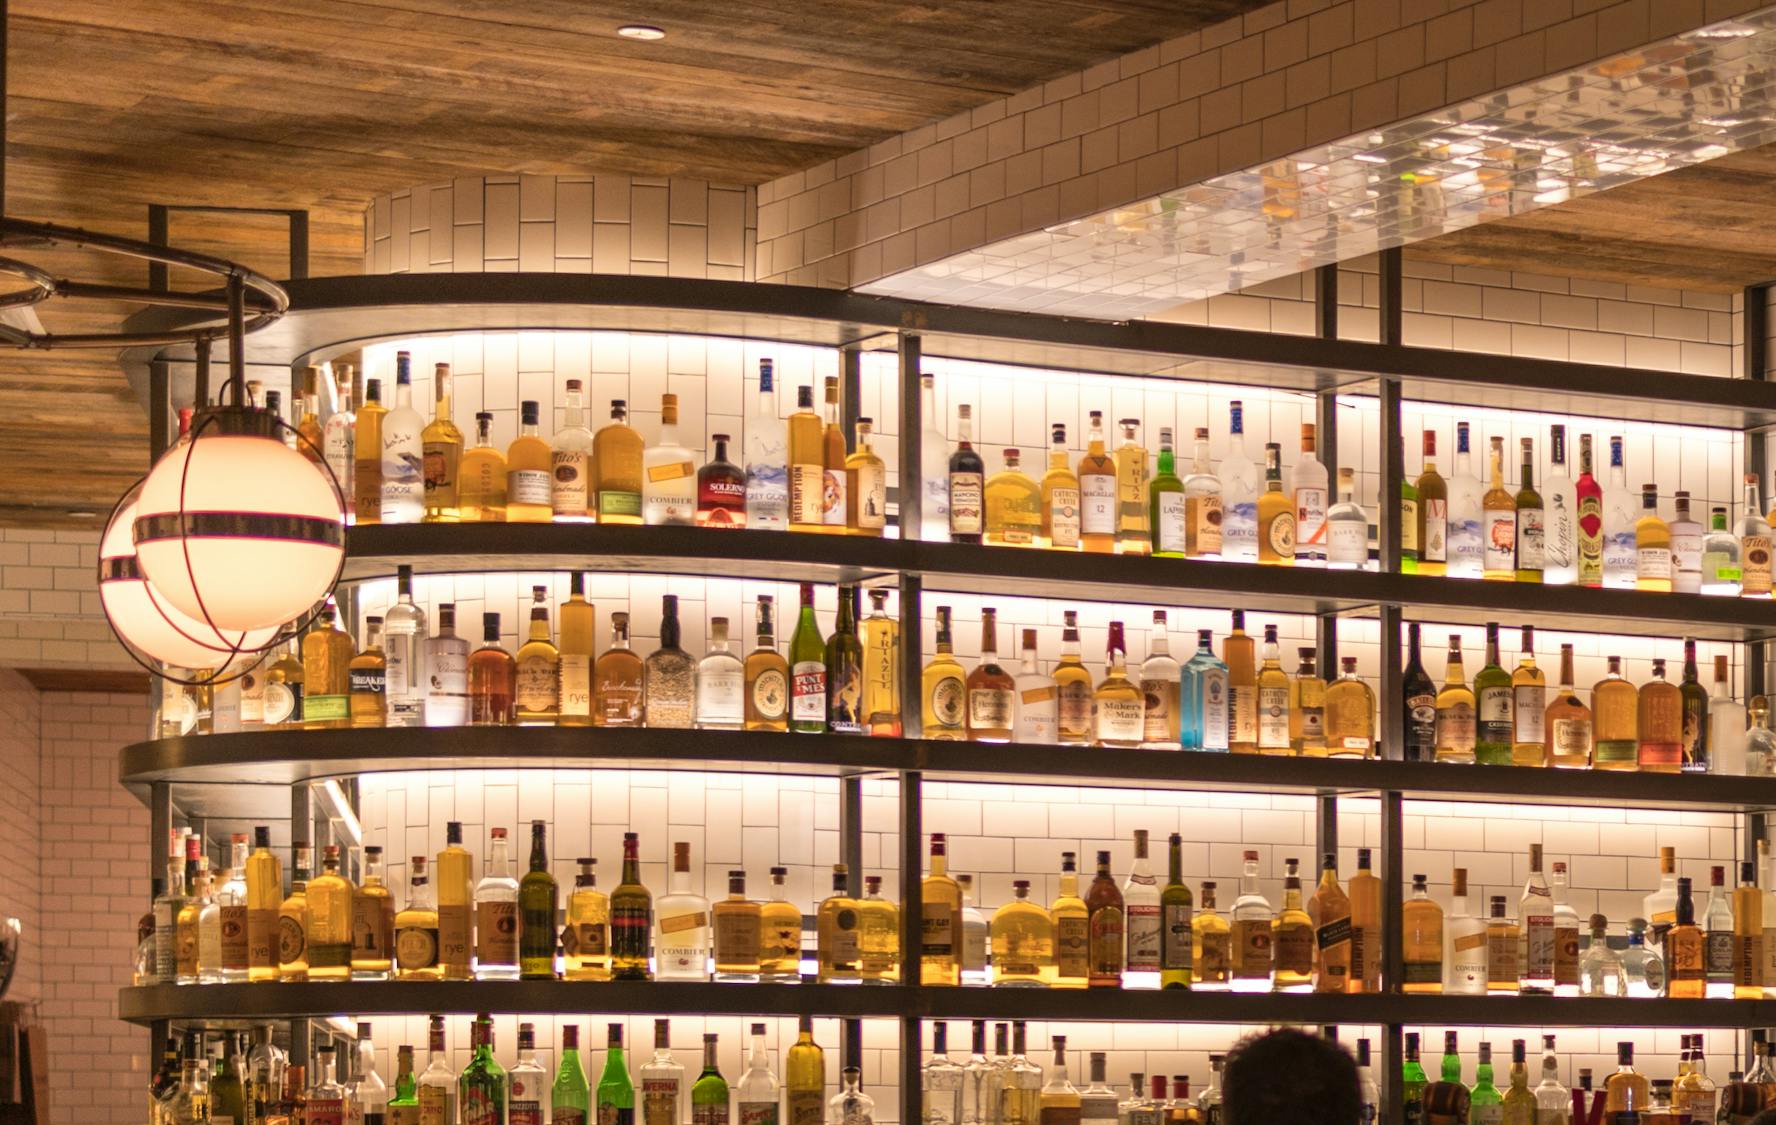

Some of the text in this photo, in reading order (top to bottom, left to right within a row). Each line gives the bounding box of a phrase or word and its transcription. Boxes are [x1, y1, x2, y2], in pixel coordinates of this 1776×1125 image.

[709, 482, 745, 492] SOLERNO
[793, 466, 803, 524] REDEMPTION
[650, 496, 692, 505] COMBIER
[569, 693, 589, 705] rye
[1104, 702, 1142, 711] Maker's
[1115, 711, 1141, 720] Mark
